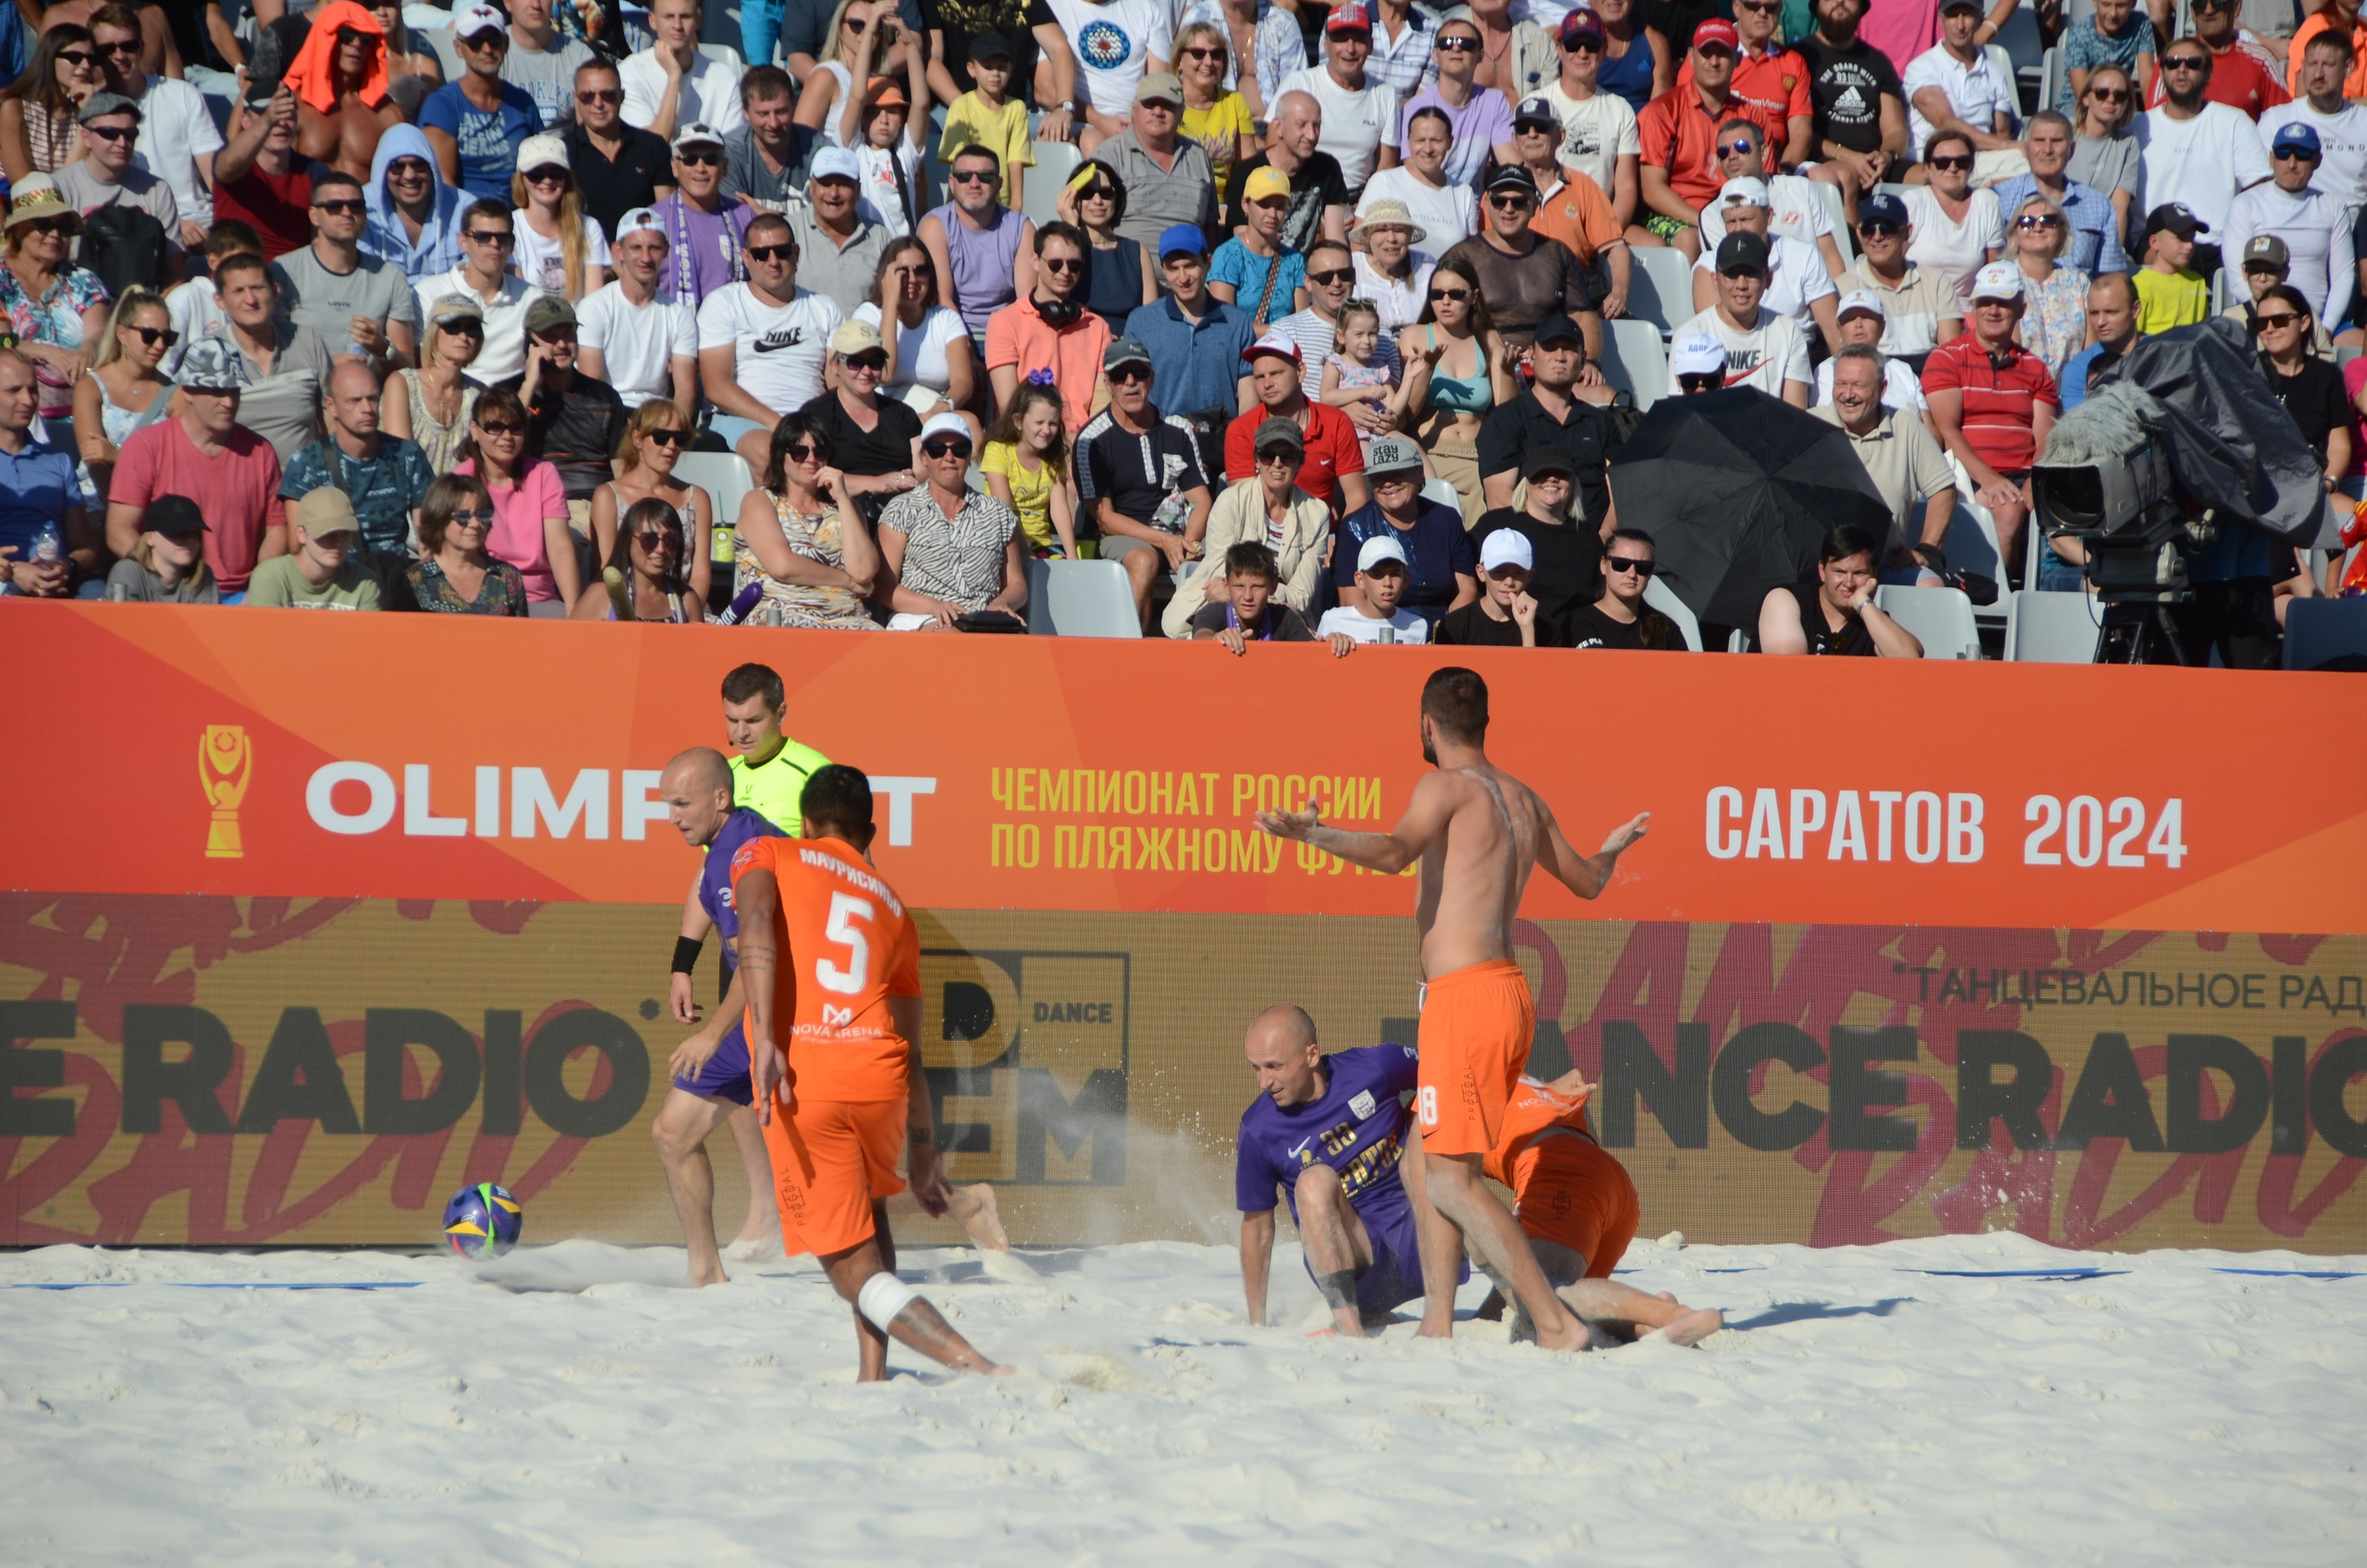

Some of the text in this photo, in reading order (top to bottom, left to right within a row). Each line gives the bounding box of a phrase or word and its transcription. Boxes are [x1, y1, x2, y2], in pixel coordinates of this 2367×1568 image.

[766, 326, 802, 344] NIKE
[1687, 344, 1709, 352] ЛДПР
[1725, 349, 1761, 370] NIKE
[304, 760, 938, 847] OLIMPT
[991, 766, 1381, 821] ЧЕМПИОНАТ РОССИИ
[990, 823, 1040, 869] ПО
[1054, 825, 1282, 875] ПЛЯЖНОМУ
[1705, 786, 2189, 868] САРАТОВ 2024
[799, 848, 902, 918] МАУРИСИНЬО
[816, 890, 874, 995] 5
[791, 1023, 883, 1038] NOVA ARENA
[1033, 1001, 1112, 1023] DANCE
[1319, 1121, 1357, 1157] 33
